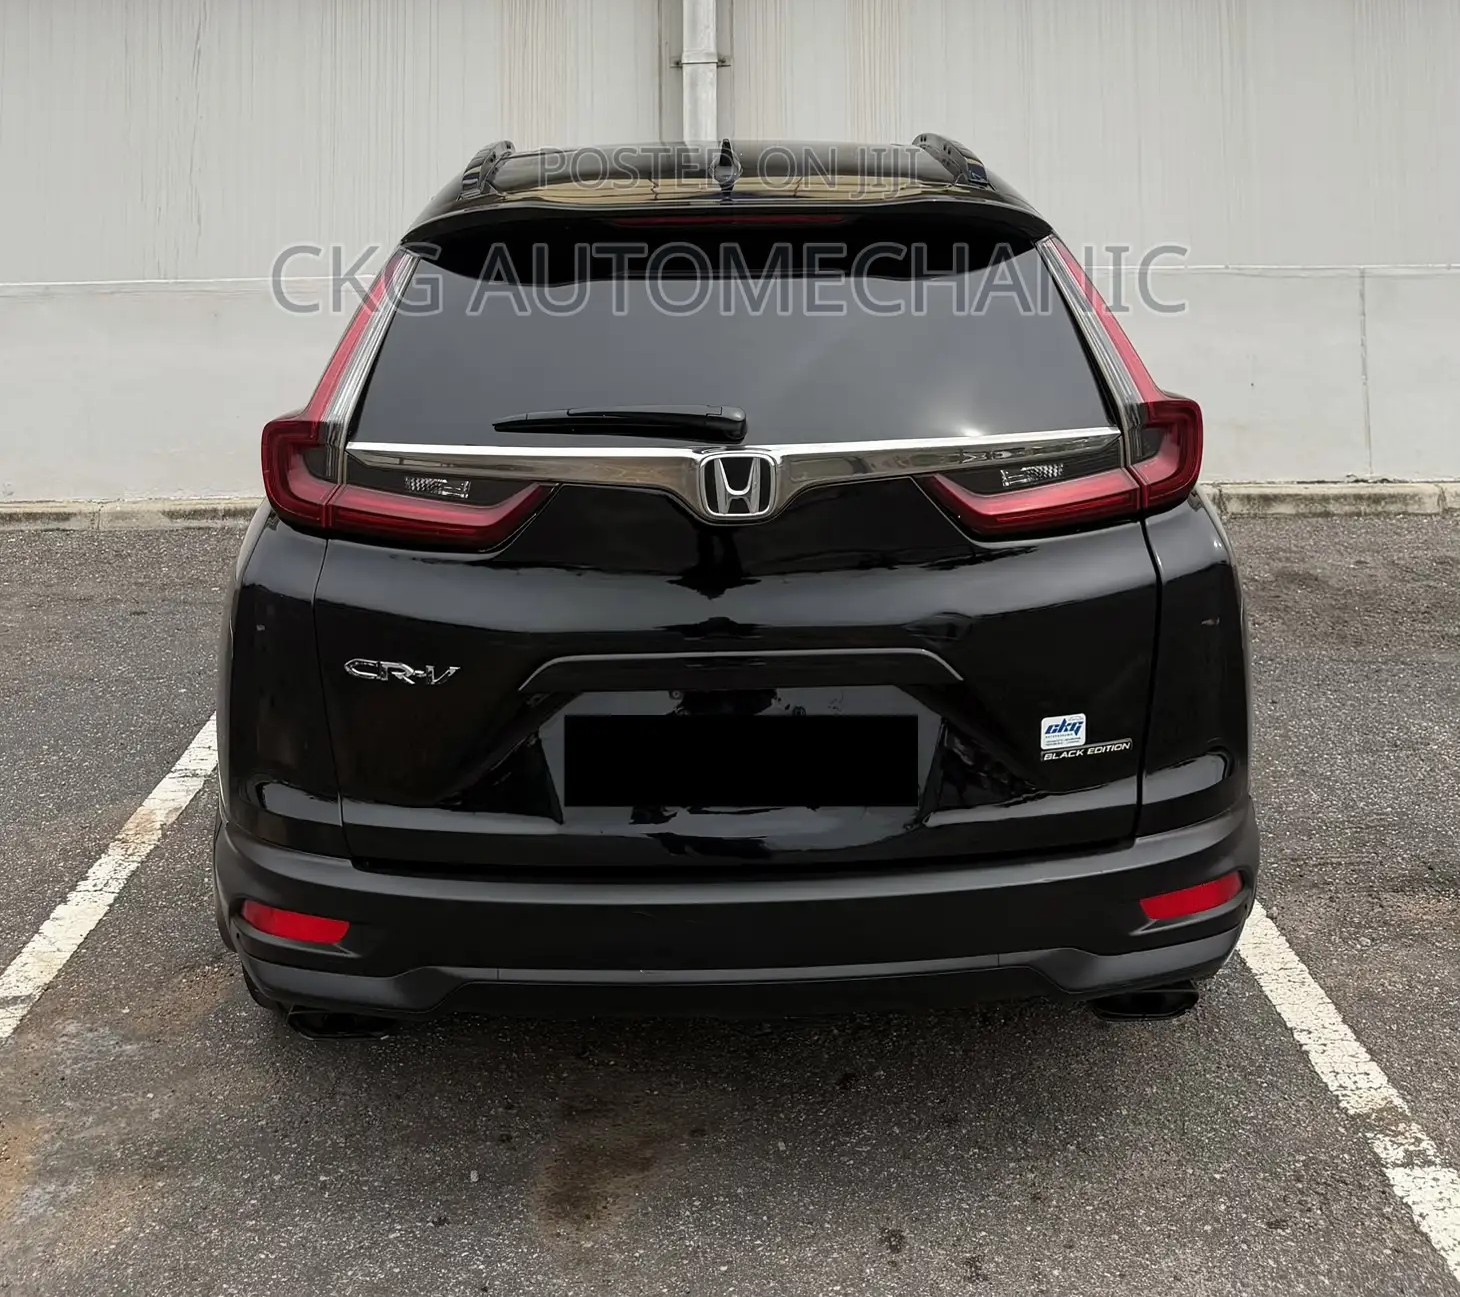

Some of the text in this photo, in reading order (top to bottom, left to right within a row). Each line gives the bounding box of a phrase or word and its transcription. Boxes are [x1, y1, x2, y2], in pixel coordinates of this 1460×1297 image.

[344, 658, 461, 685] CR-V
[1043, 742, 1131, 761] BLACK EDITION
